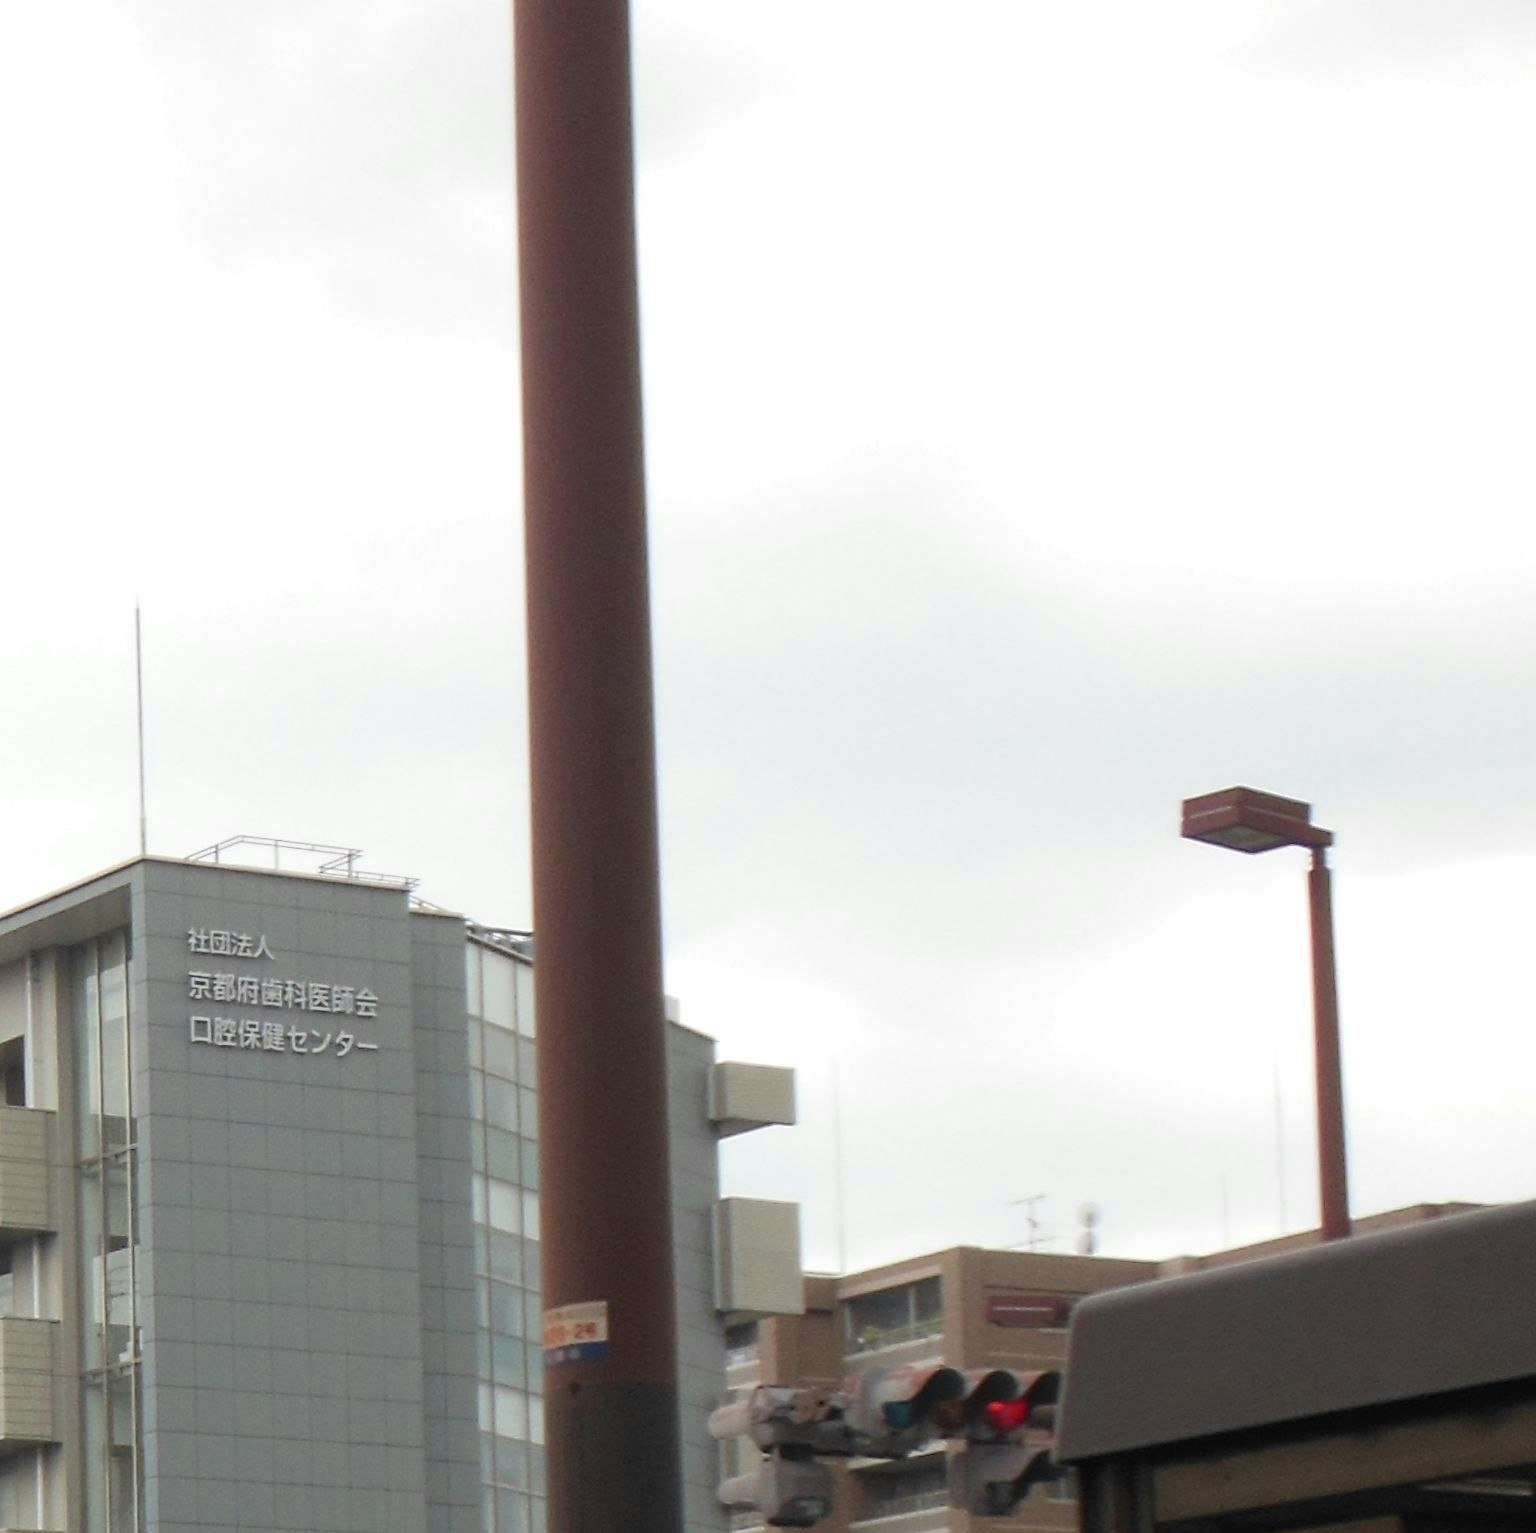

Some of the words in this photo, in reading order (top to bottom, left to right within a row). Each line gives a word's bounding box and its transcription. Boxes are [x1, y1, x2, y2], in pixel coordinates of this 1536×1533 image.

[187, 927, 275, 961] 社団法人
[188, 971, 380, 1018] 京都府歯科医師会
[190, 1015, 379, 1058] 口腔保健センター
